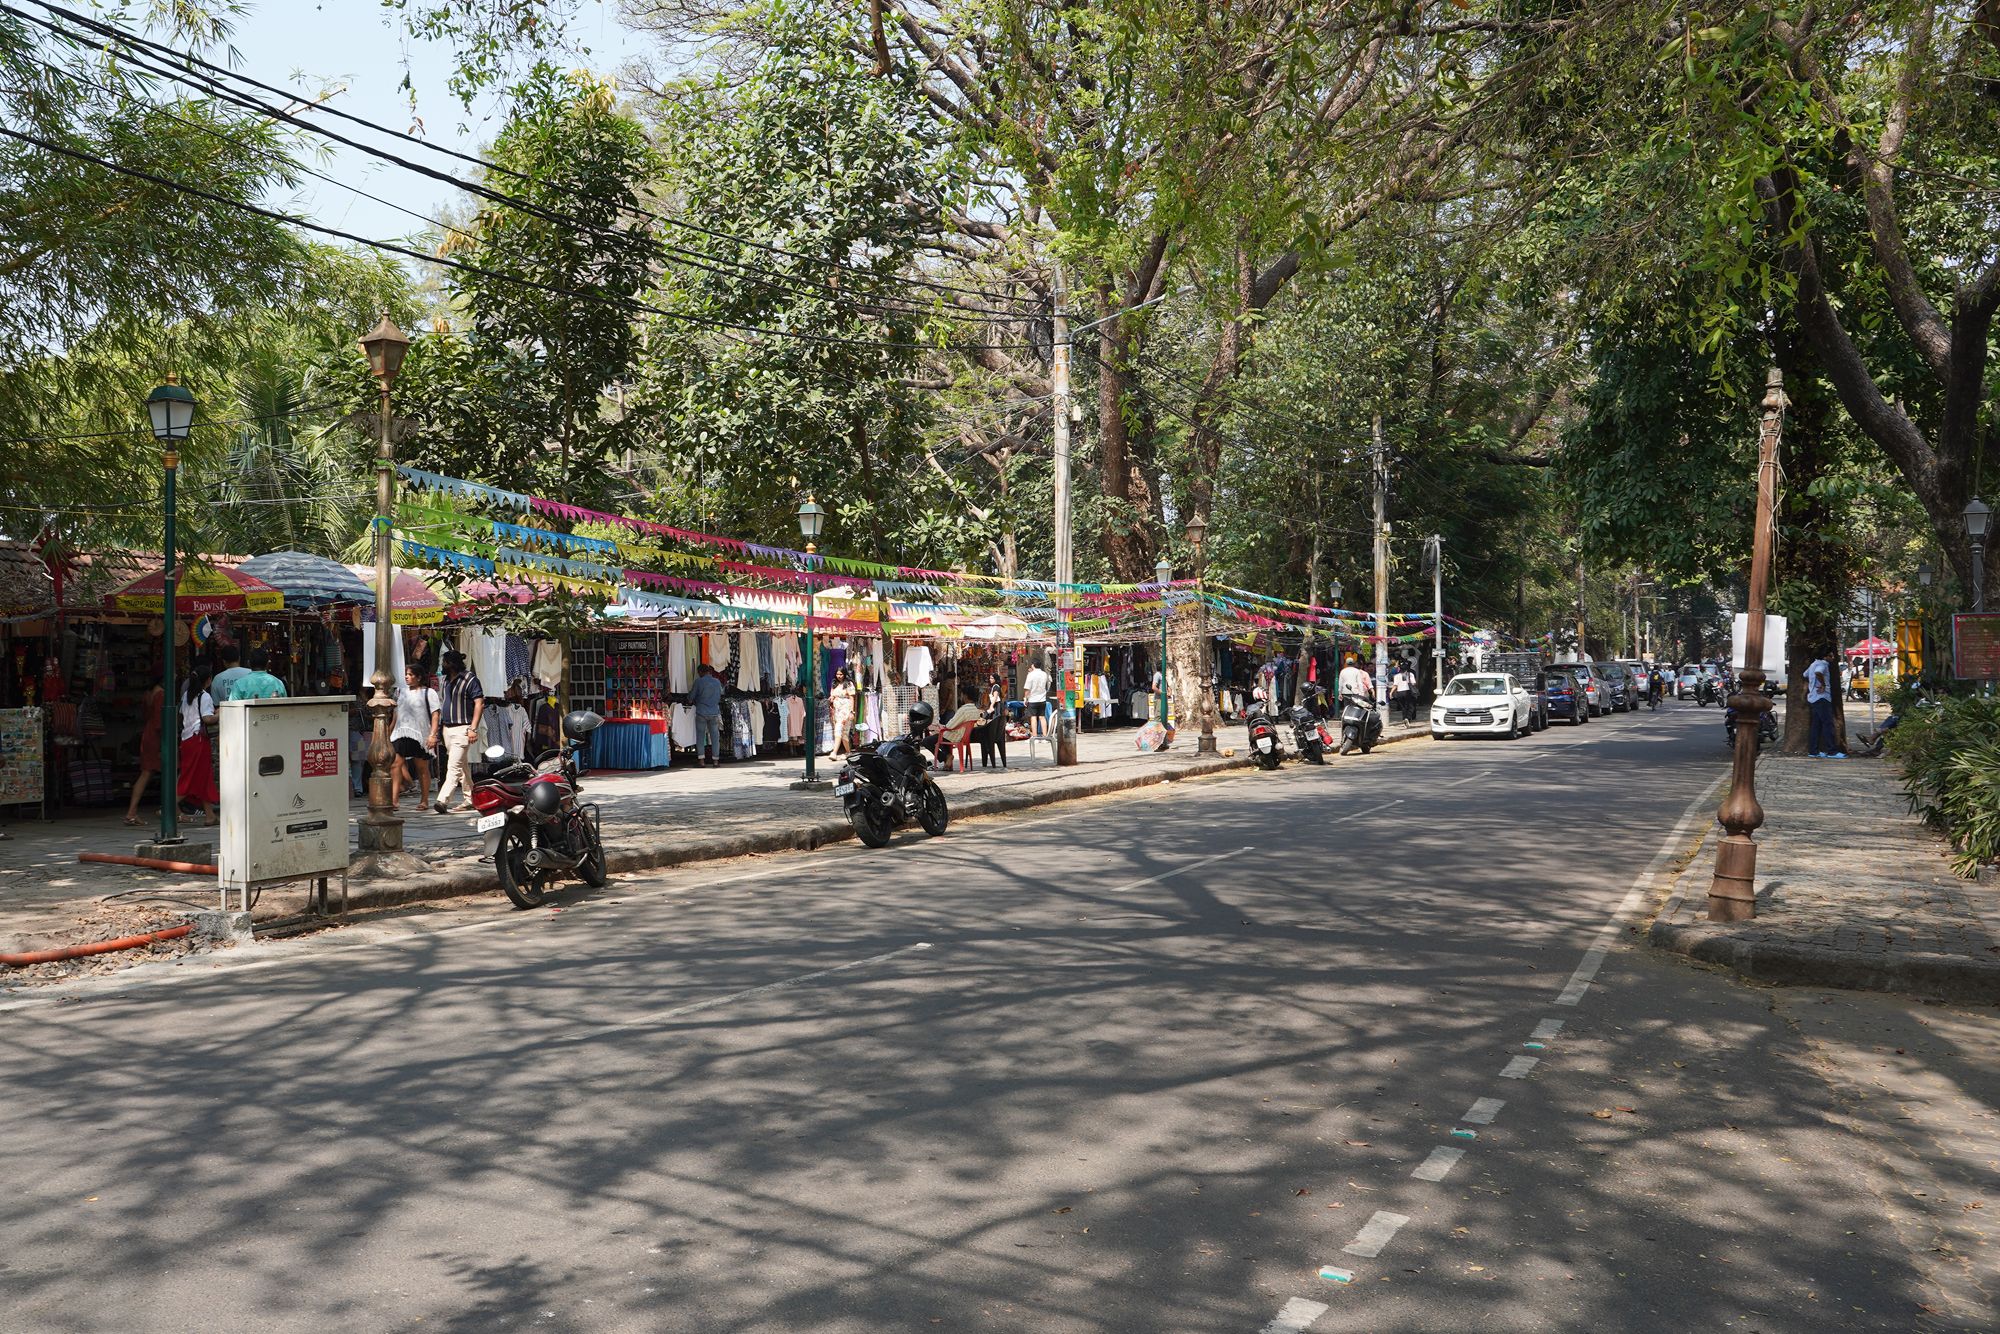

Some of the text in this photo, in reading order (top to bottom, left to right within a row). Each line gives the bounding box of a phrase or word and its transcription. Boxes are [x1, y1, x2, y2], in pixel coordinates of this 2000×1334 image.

[394, 611, 436, 621] STUDY ABROAD
[304, 741, 335, 751] DANGER
